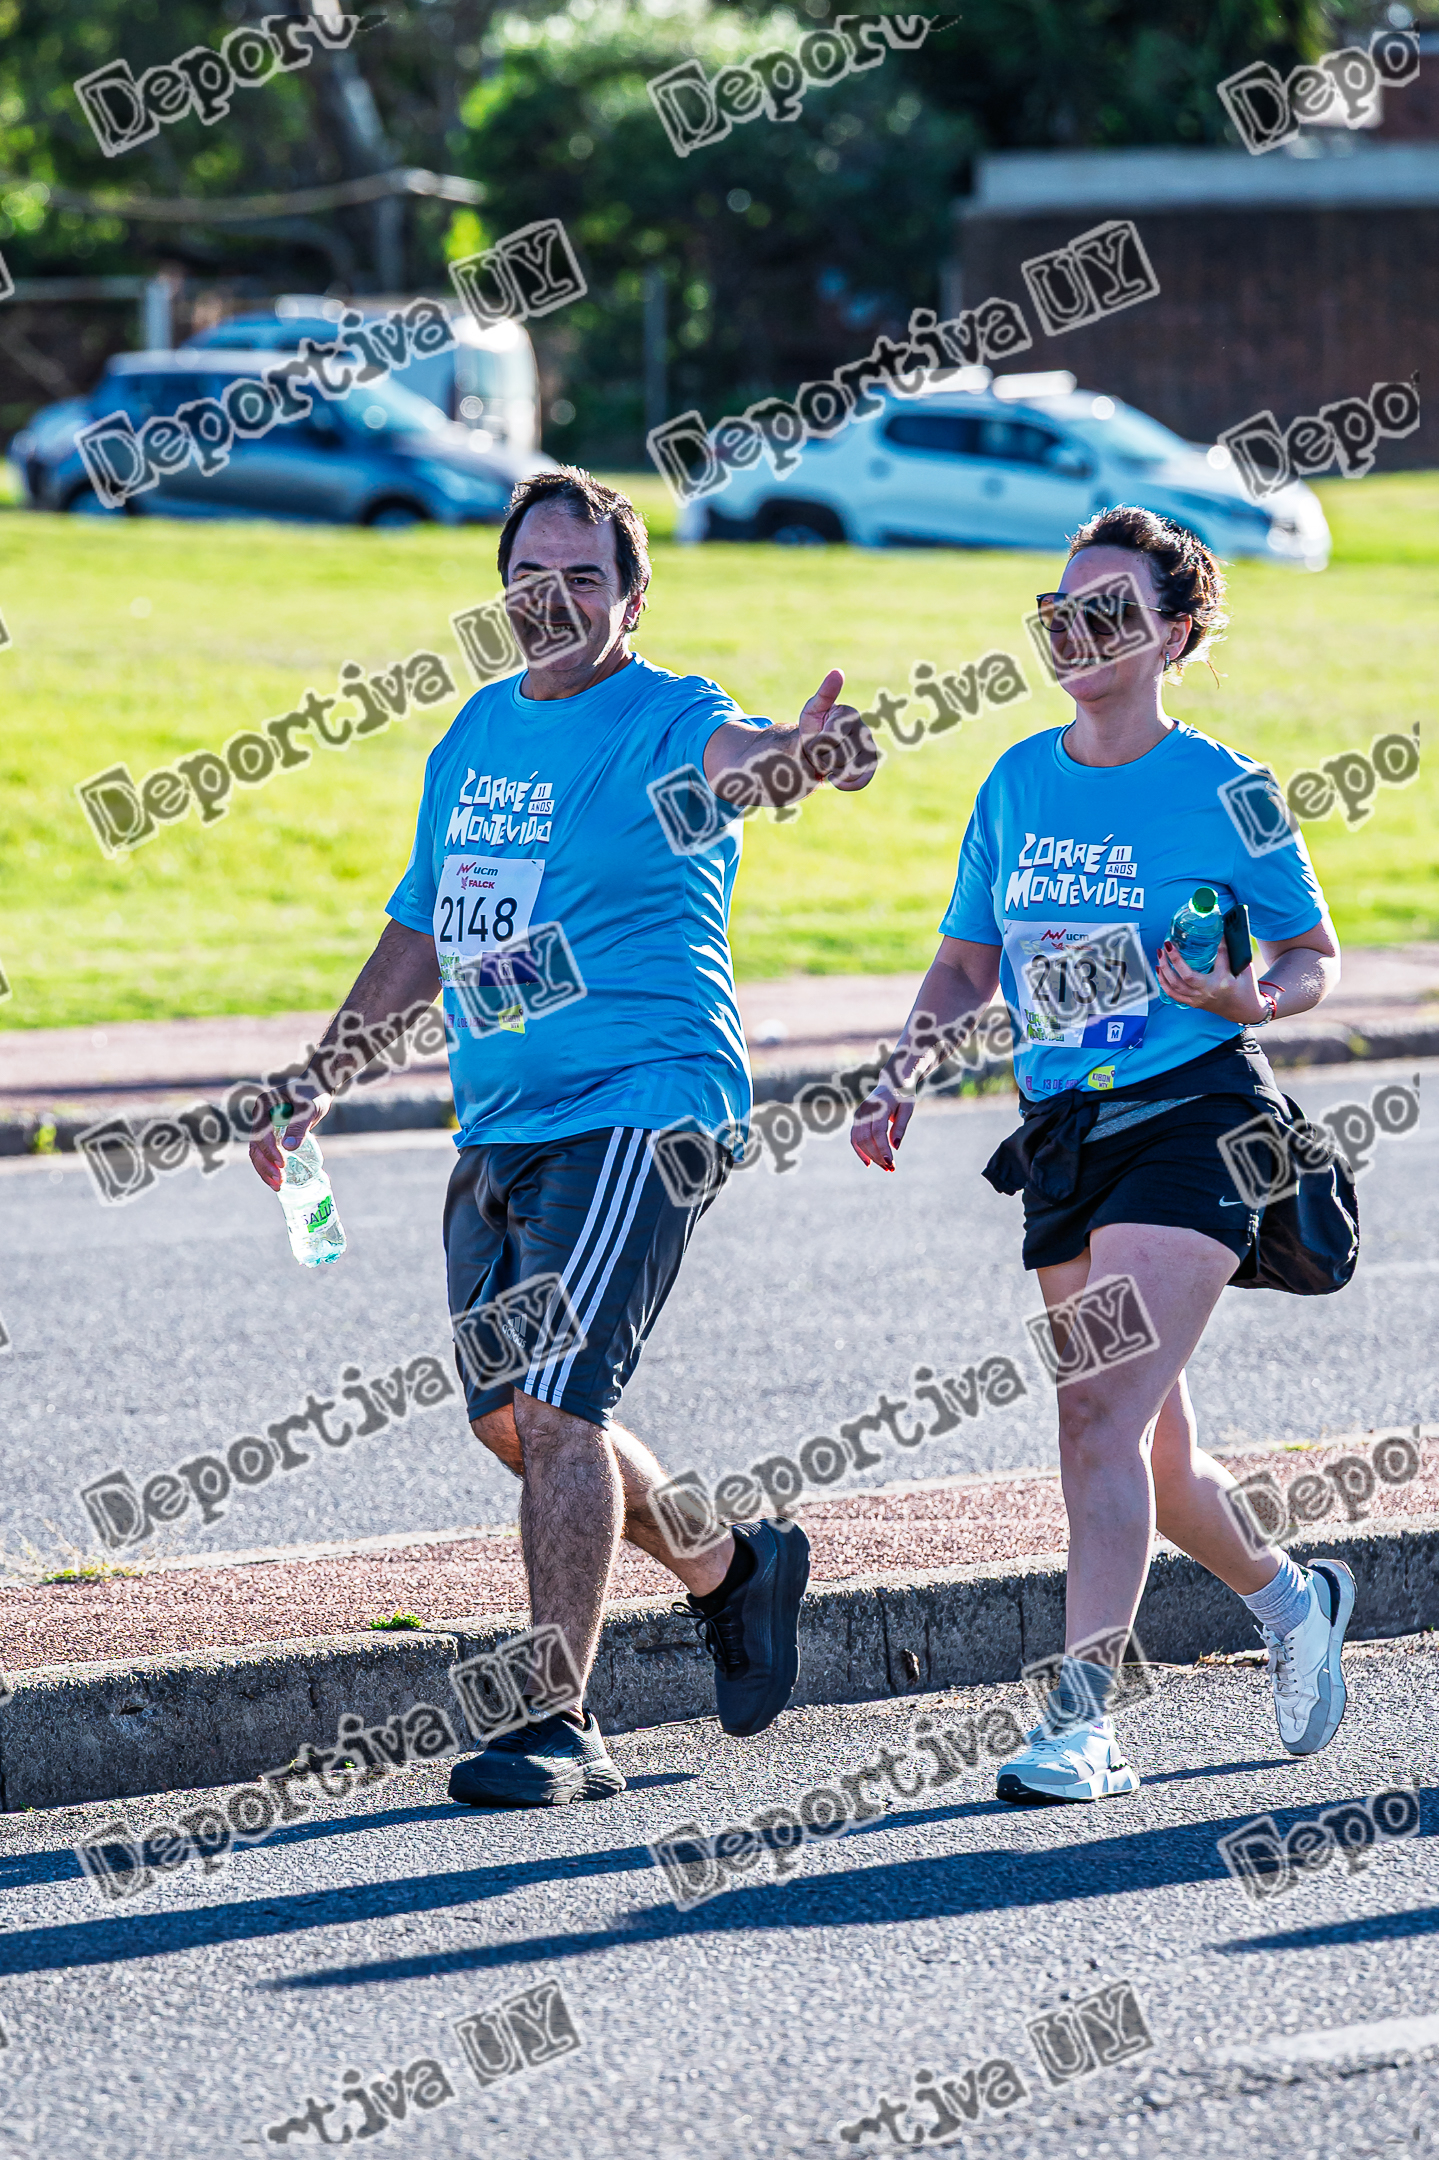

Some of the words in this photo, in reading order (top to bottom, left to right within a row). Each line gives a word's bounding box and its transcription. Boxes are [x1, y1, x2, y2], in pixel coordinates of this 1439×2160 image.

[459, 767, 538, 812] CORRÉ
[530, 801, 551, 813] AÑOS
[1018, 833, 1115, 873] CORRÉ
[473, 866, 498, 877] ucm
[1108, 864, 1134, 875] AÑOS
[468, 879, 496, 889] FALCK
[1005, 868, 1144, 913] MONTEVIDEO
[439, 895, 518, 943] 2148
[1066, 933, 1090, 941] ucm
[1031, 954, 1127, 1004] 2137
